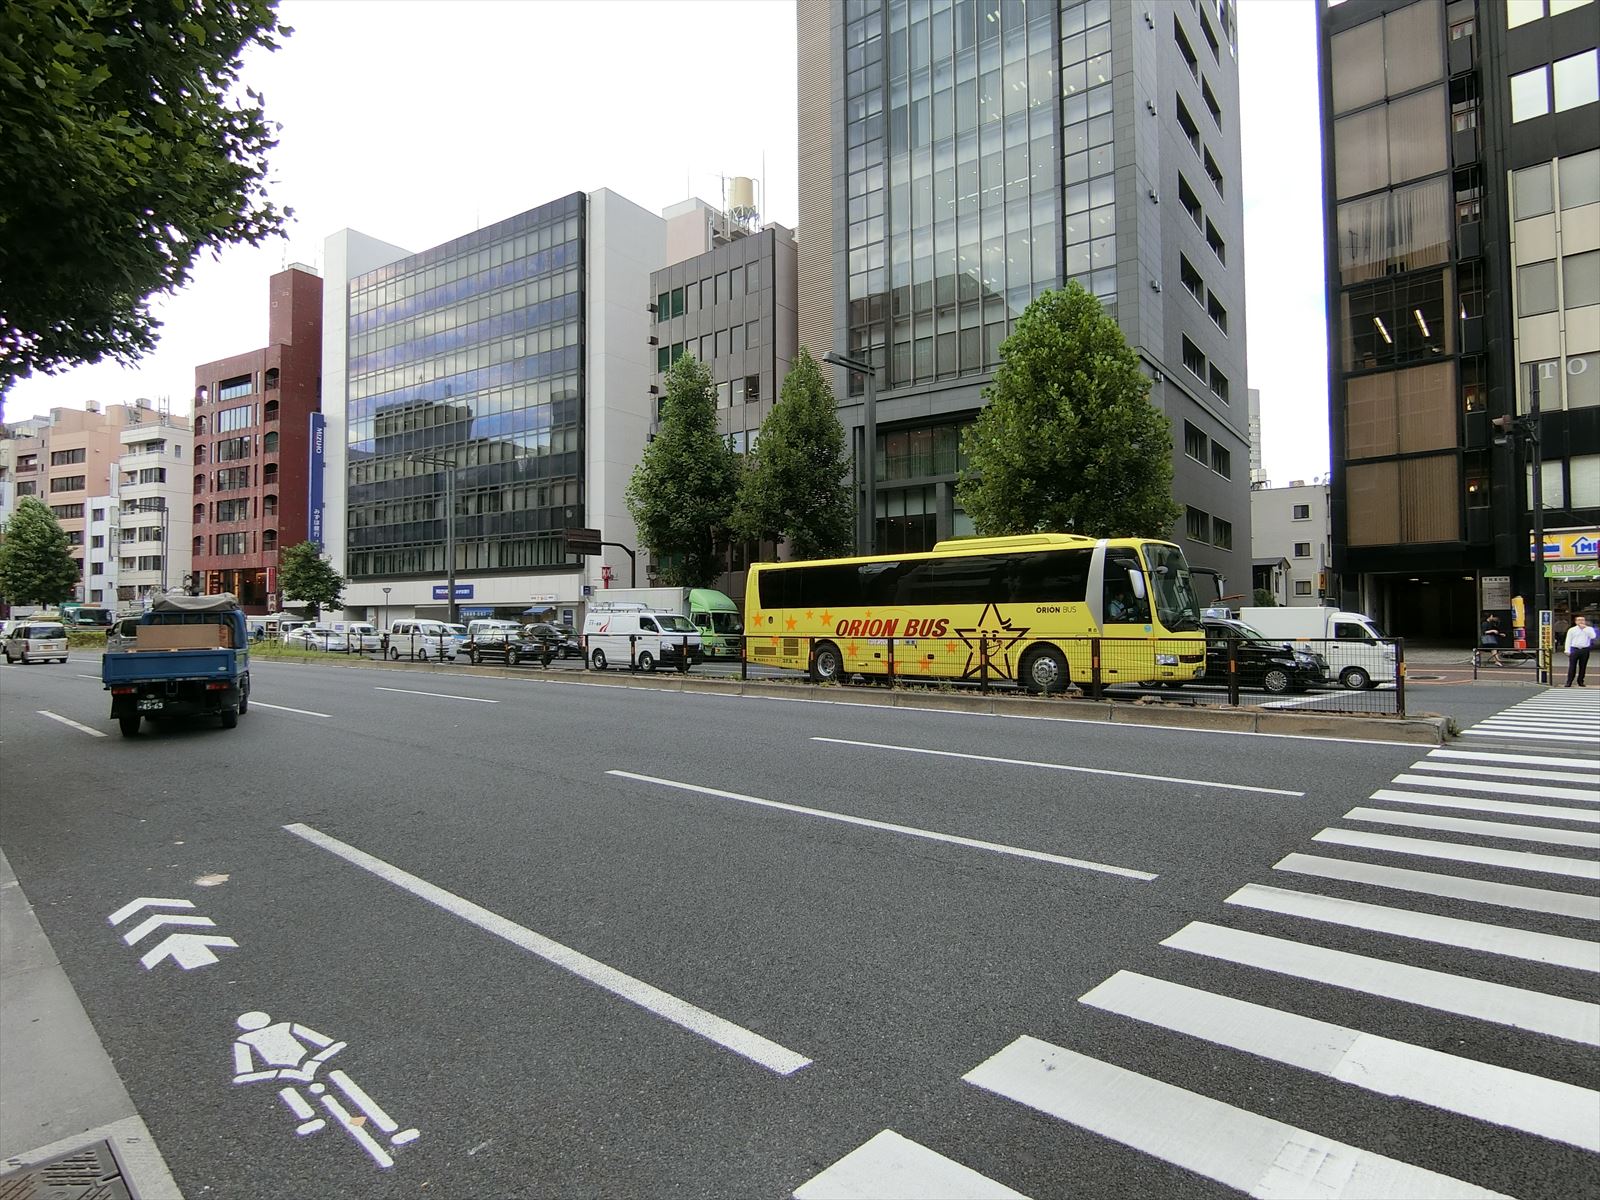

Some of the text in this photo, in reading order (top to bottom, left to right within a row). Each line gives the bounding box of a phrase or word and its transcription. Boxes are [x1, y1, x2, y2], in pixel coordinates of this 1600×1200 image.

[1062, 605, 1077, 613] BUS
[835, 618, 950, 637] ORION BUS
